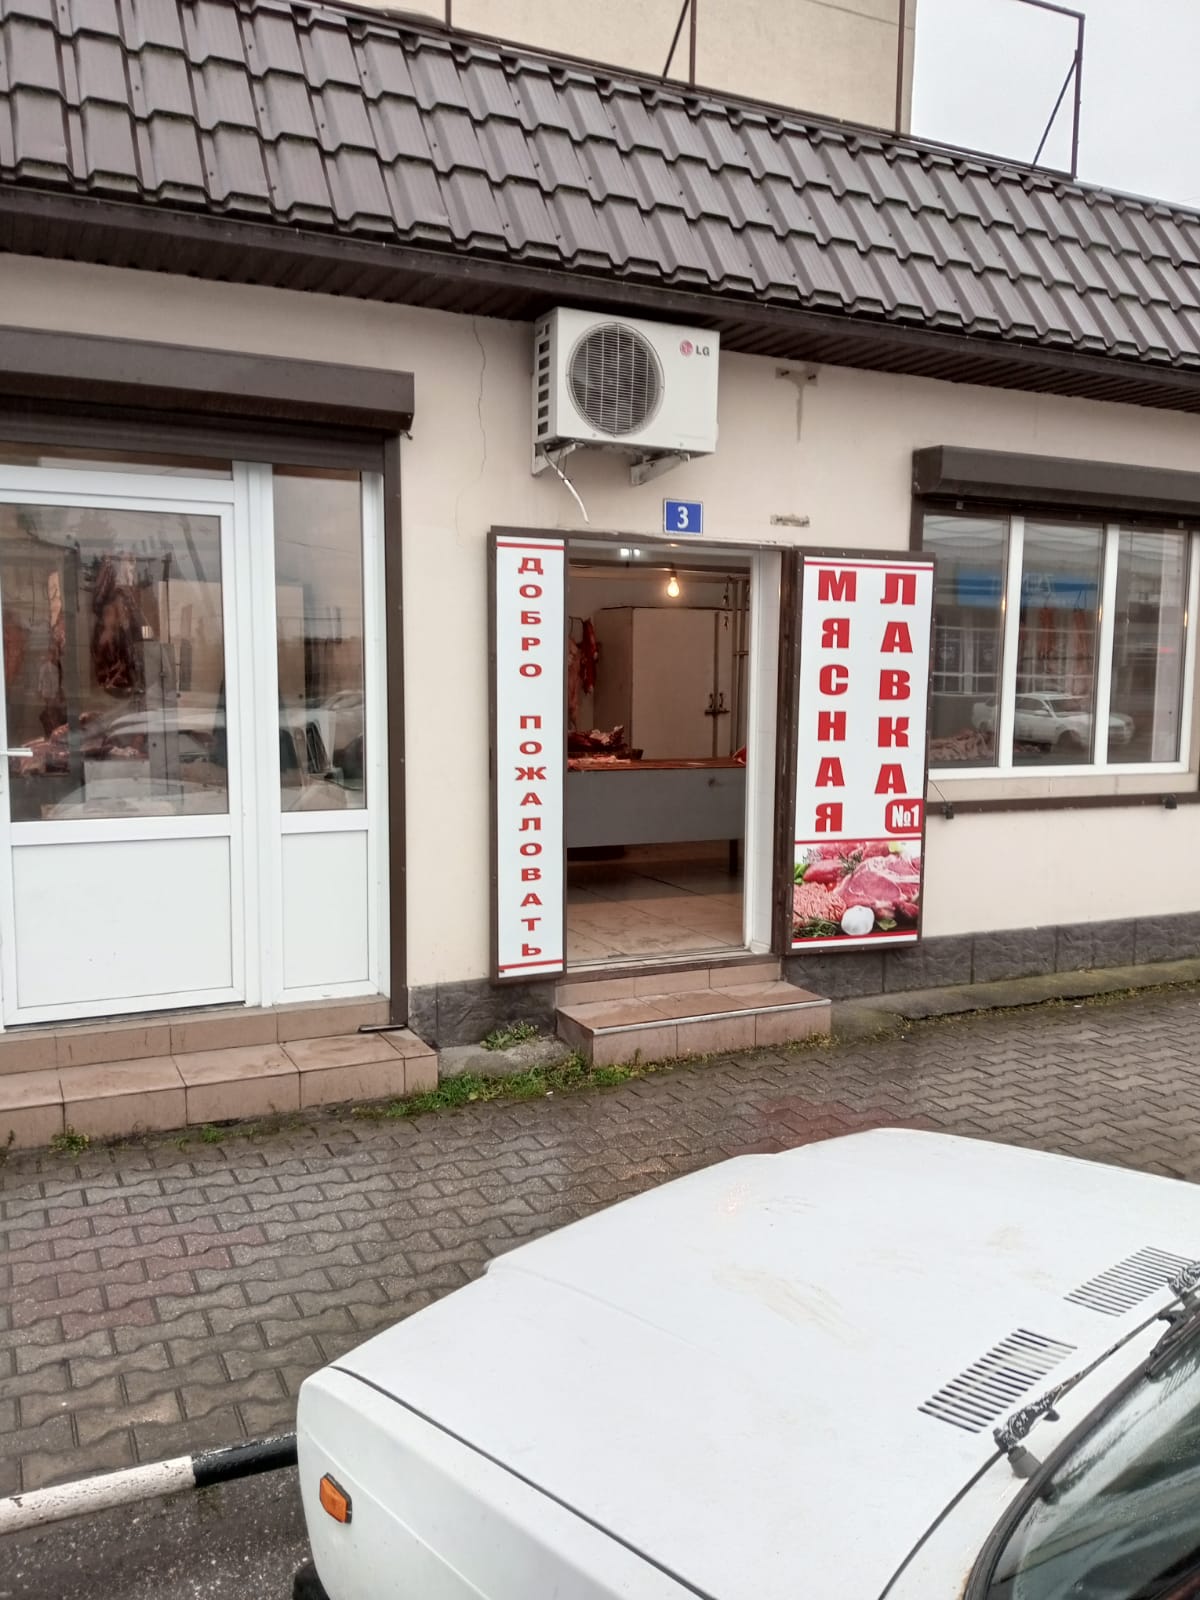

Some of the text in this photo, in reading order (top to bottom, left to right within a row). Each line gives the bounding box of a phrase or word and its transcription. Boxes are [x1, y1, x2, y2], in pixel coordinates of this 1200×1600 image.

[696, 345, 710, 357] LG
[677, 506, 689, 529] 3
[814, 569, 857, 833] МЯСНАЯ
[874, 572, 917, 794] ЛАВКА
[514, 557, 547, 957] ДОБРО ПОЖАЛОВАТЬ
[891, 804, 920, 828] №1
